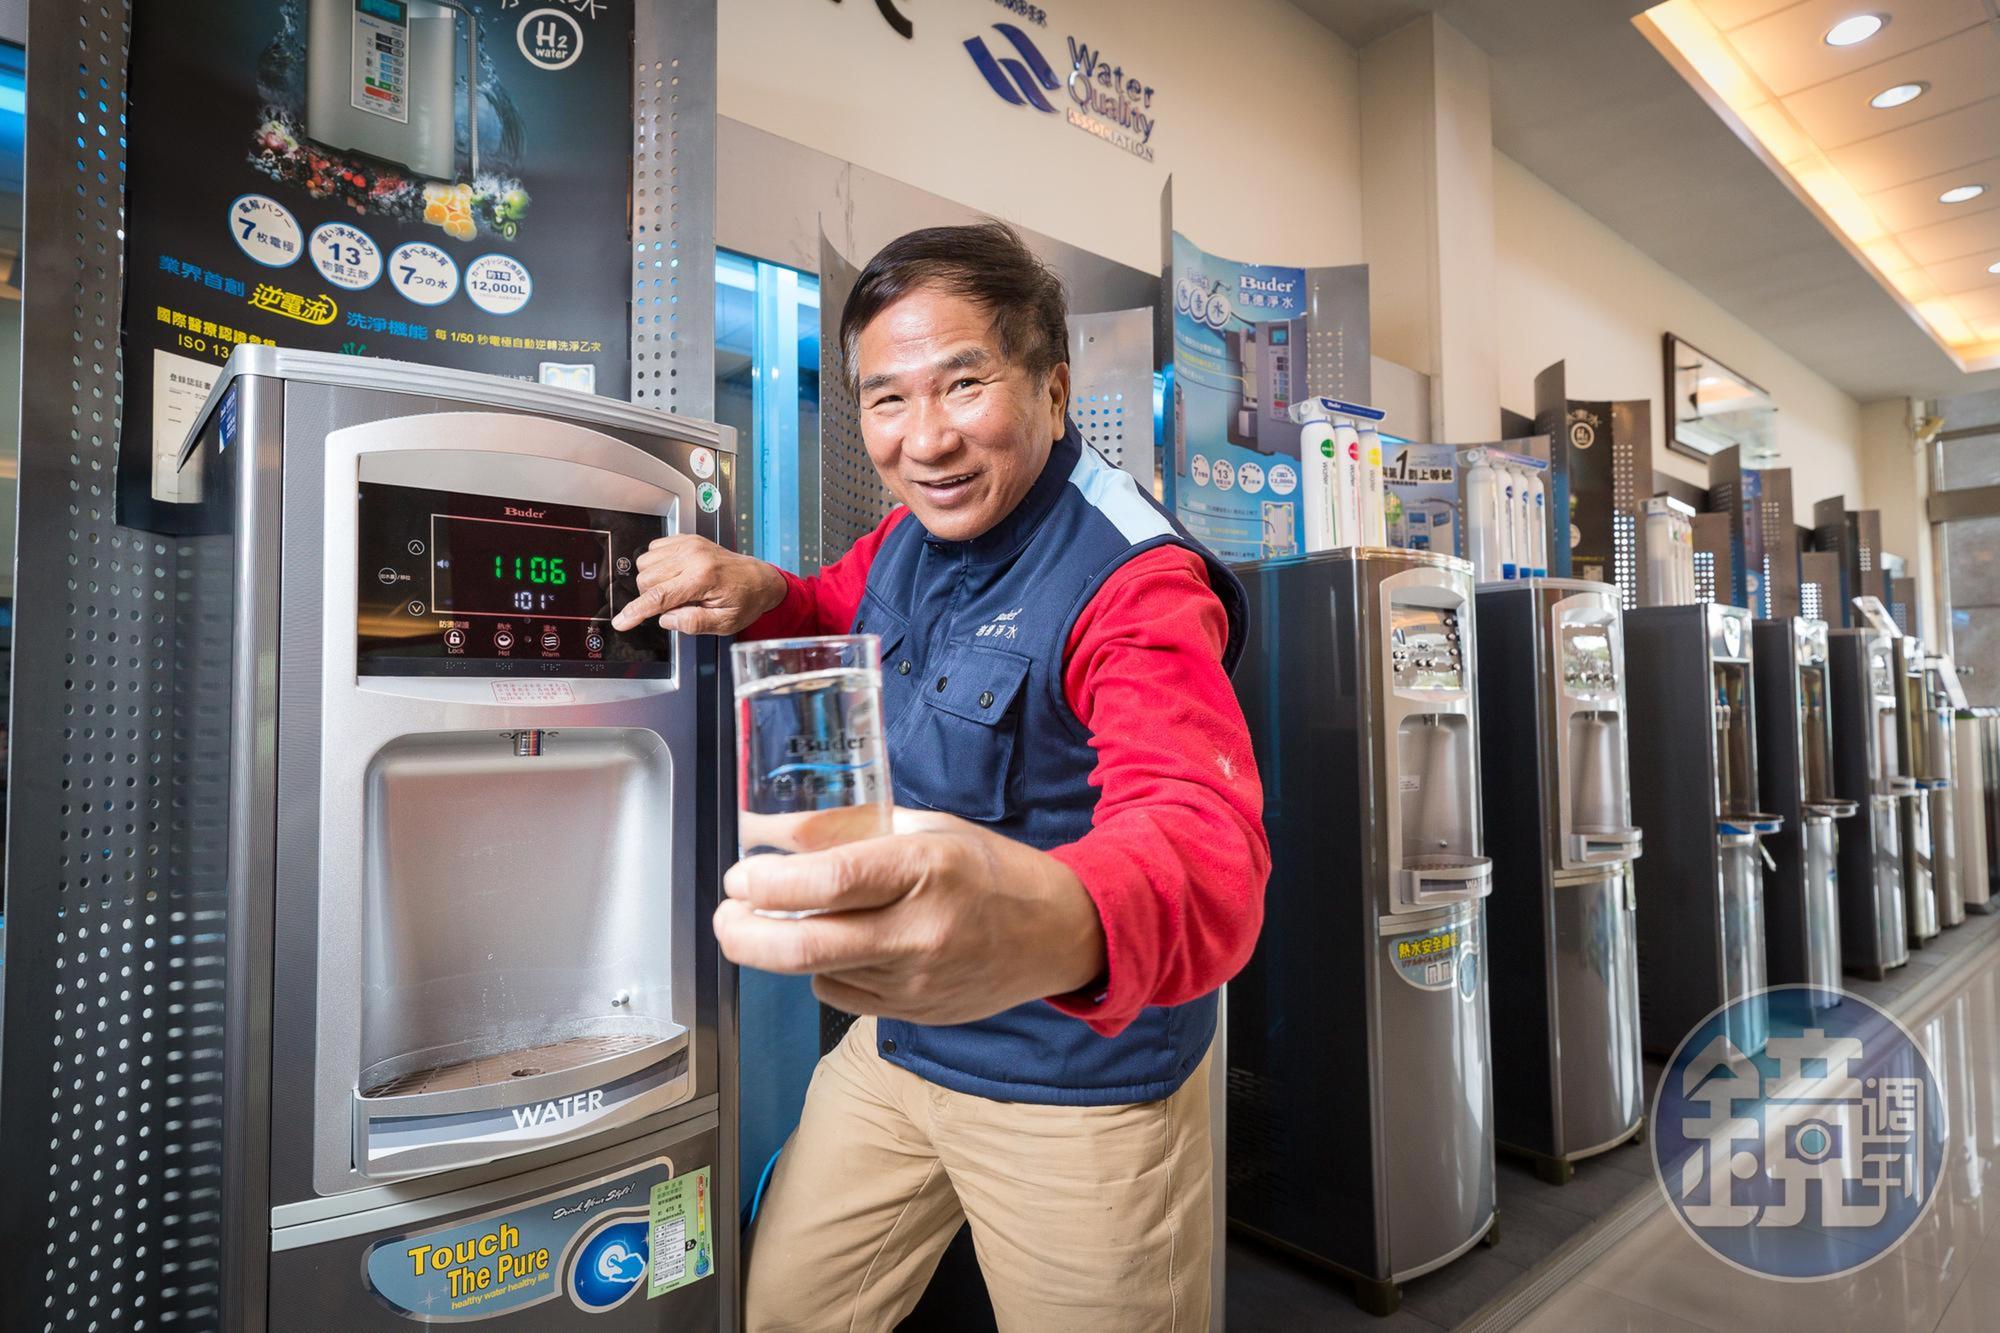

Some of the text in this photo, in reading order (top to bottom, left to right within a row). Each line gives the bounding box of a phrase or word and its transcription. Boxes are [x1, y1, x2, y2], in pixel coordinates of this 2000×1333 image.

[535, 47, 569, 59] water
[1067, 35, 1154, 109] Water
[1068, 70, 1155, 144] Quality
[1068, 108, 1154, 161] ASSOCIATION
[328, 243, 361, 266] 13
[159, 255, 245, 298] 業界首創
[322, 259, 370, 281] 物質去除
[471, 281, 527, 296] 12,000L
[1240, 276, 1294, 292] Buder
[248, 283, 331, 322] 逆電流
[346, 311, 429, 341] 洗淨機能
[450, 331, 474, 344] 1/50
[178, 334, 206, 352] ISO
[504, 507, 544, 518] Buder
[448, 647, 464, 655] Lock
[588, 651, 602, 659] Cold
[790, 730, 865, 754] Buder
[513, 1090, 604, 1128] WATER
[552, 1201, 583, 1219] Drink
[584, 1197, 605, 1212] Your
[407, 1222, 519, 1277] Touch
[447, 1247, 549, 1298] The Pure
[452, 1271, 550, 1310] healthy water healthy life
